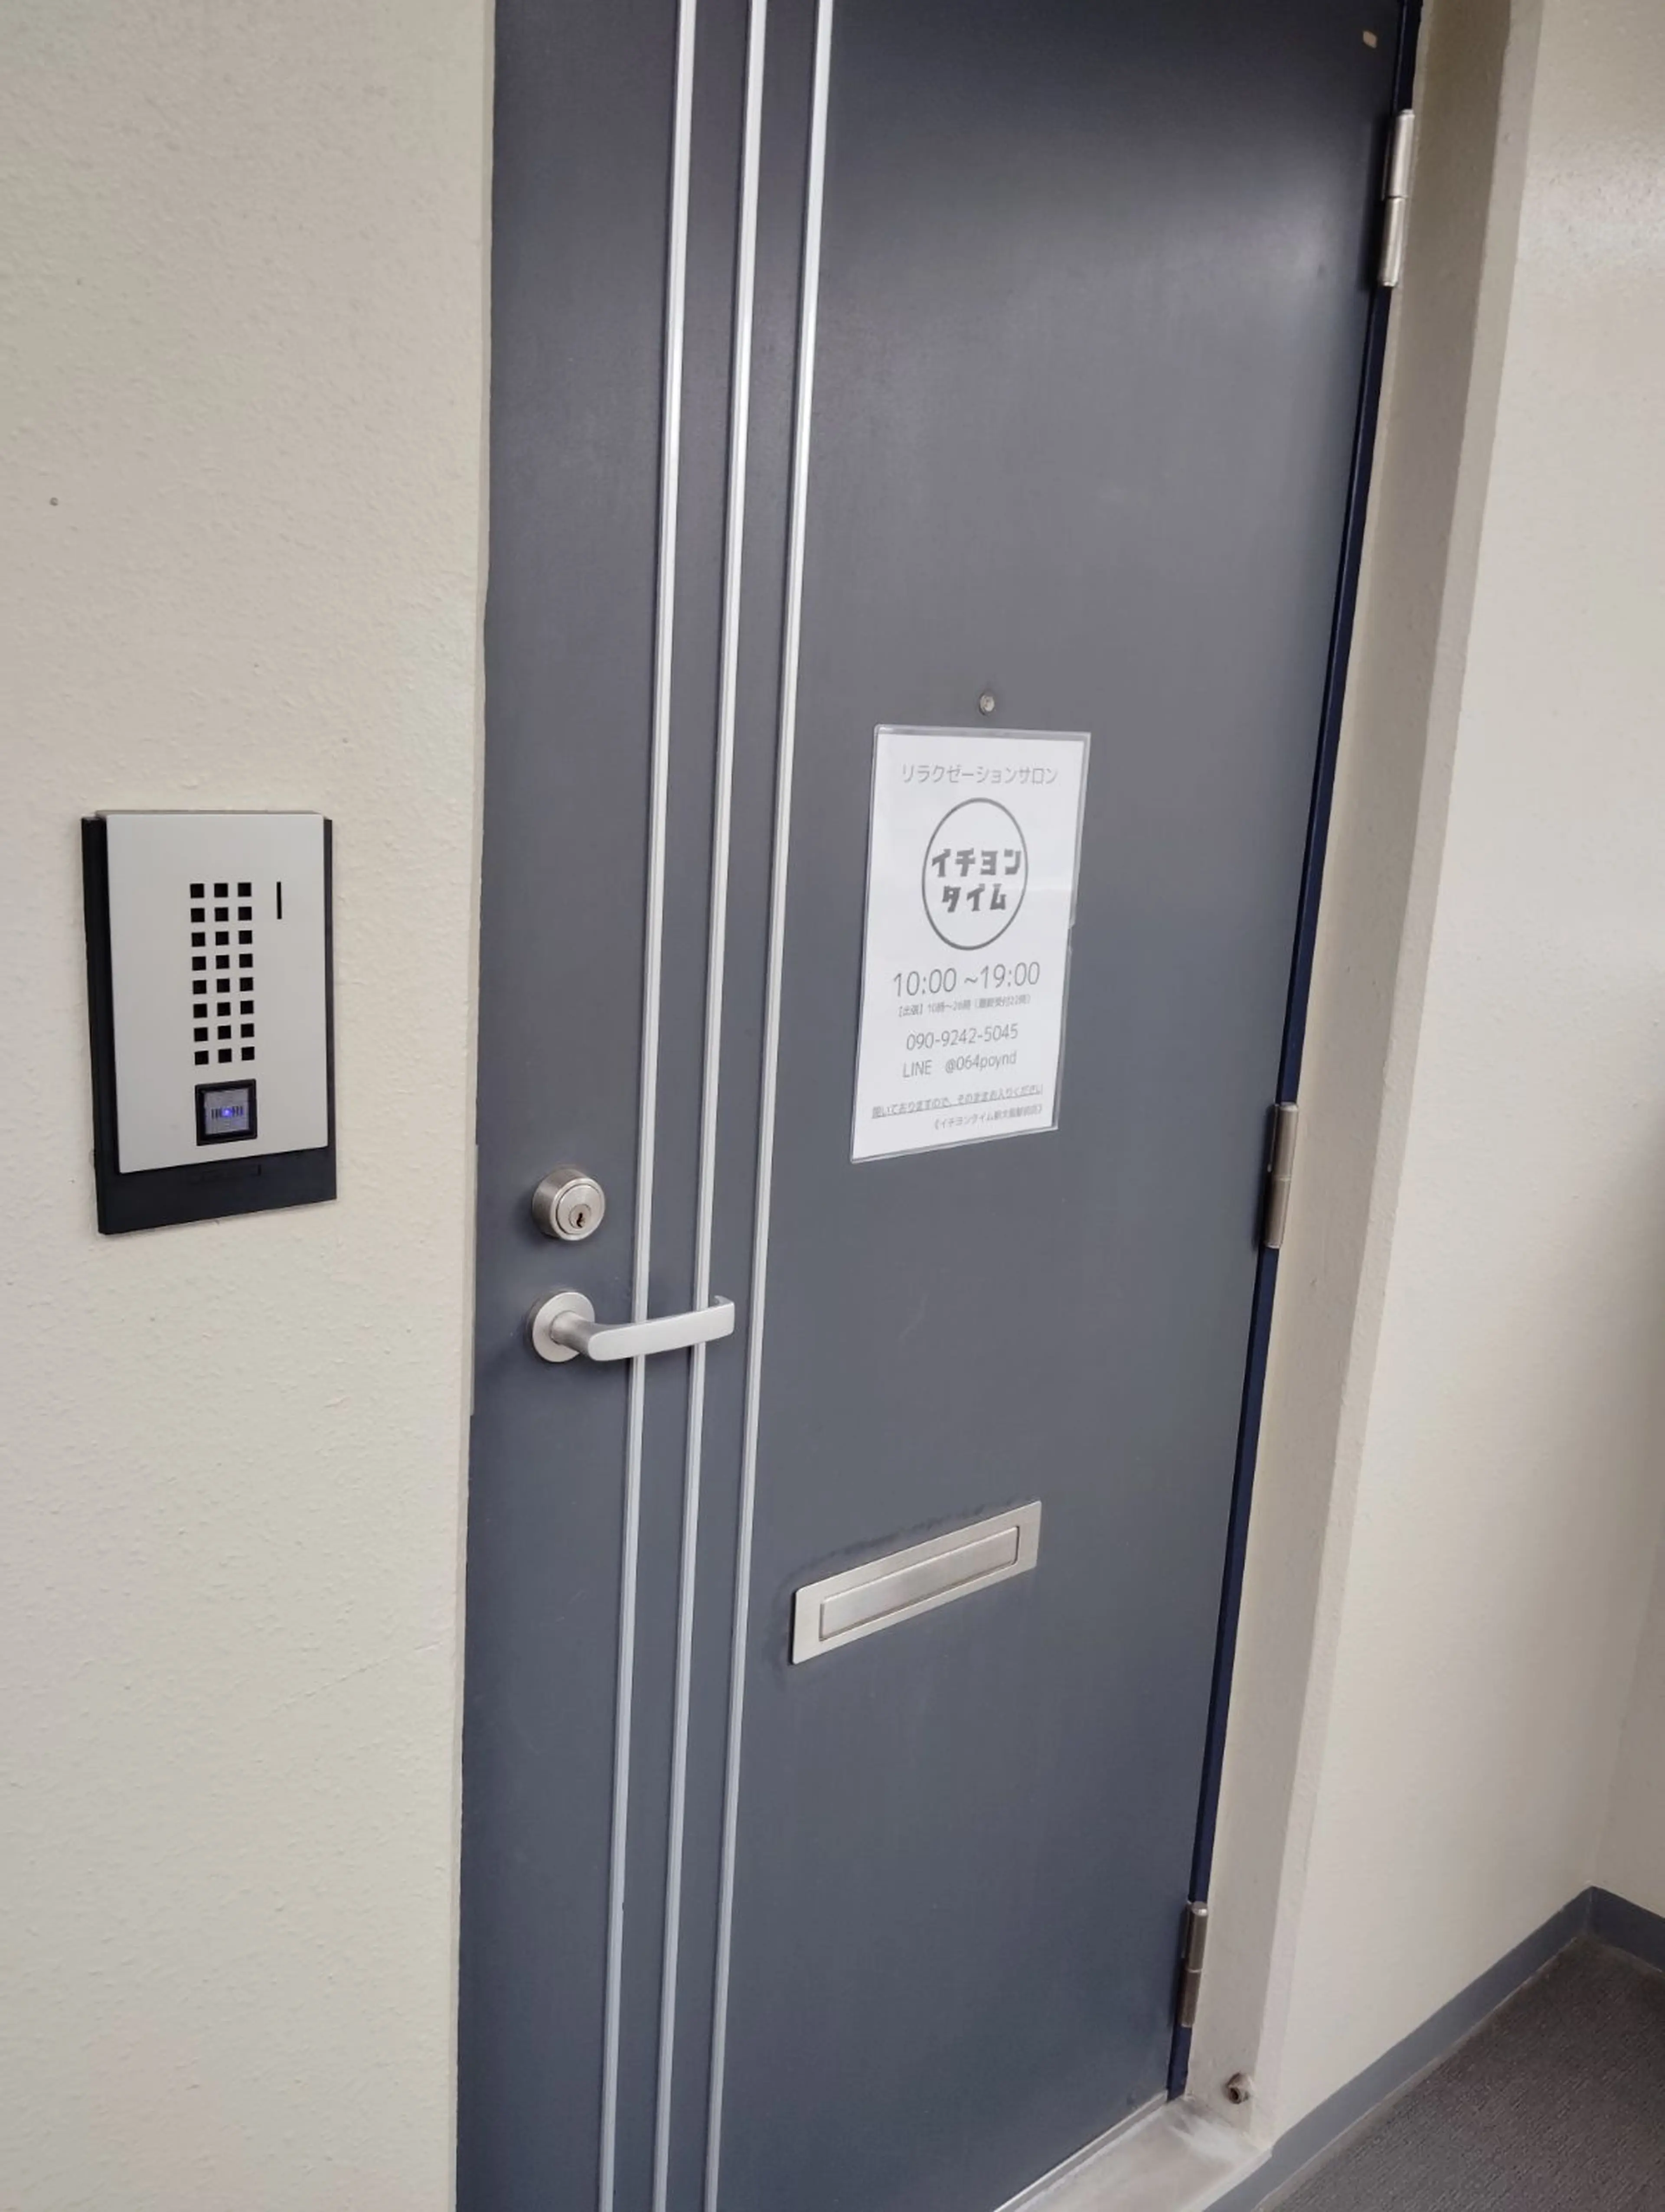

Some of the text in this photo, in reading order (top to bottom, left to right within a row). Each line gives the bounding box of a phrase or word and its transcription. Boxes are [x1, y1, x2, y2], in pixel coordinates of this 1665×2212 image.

[902, 764, 1058, 784] リラクゼーションサロン
[932, 848, 1022, 878] イチヨン
[941, 883, 1007, 913] タイム
[893, 967, 957, 997] 10:00
[906, 1023, 1018, 1051] 090-9242-5045
[902, 1059, 932, 1078] LINE
